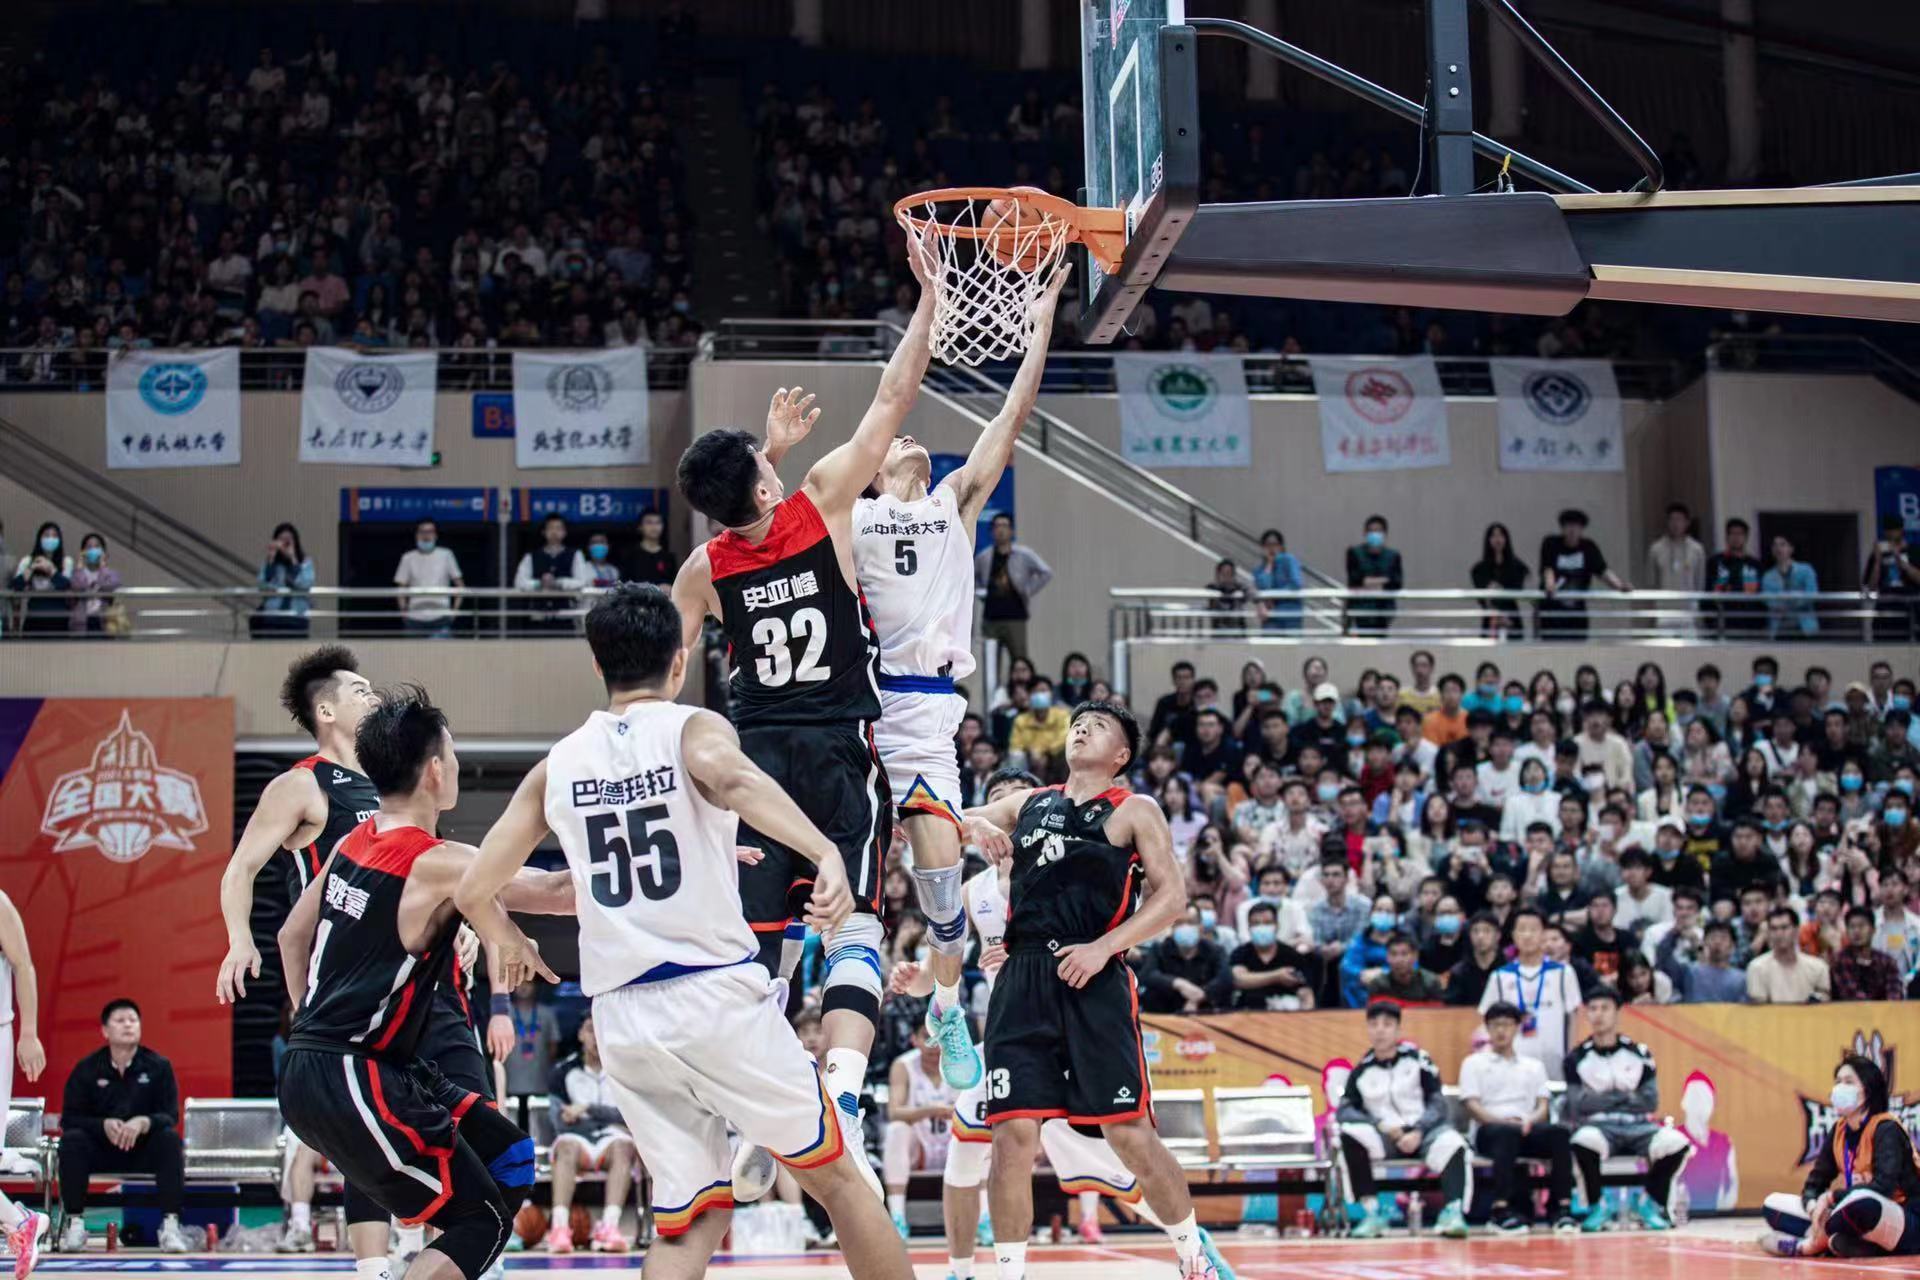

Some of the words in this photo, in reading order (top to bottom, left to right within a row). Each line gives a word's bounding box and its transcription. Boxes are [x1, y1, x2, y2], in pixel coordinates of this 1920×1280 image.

[894, 539, 919, 577] 5
[741, 570, 820, 613] 史亚峰
[751, 606, 832, 688] 32
[49, 774, 200, 826] 全国大赛
[572, 765, 679, 808] 巴德玛拉
[584, 803, 682, 908] 55
